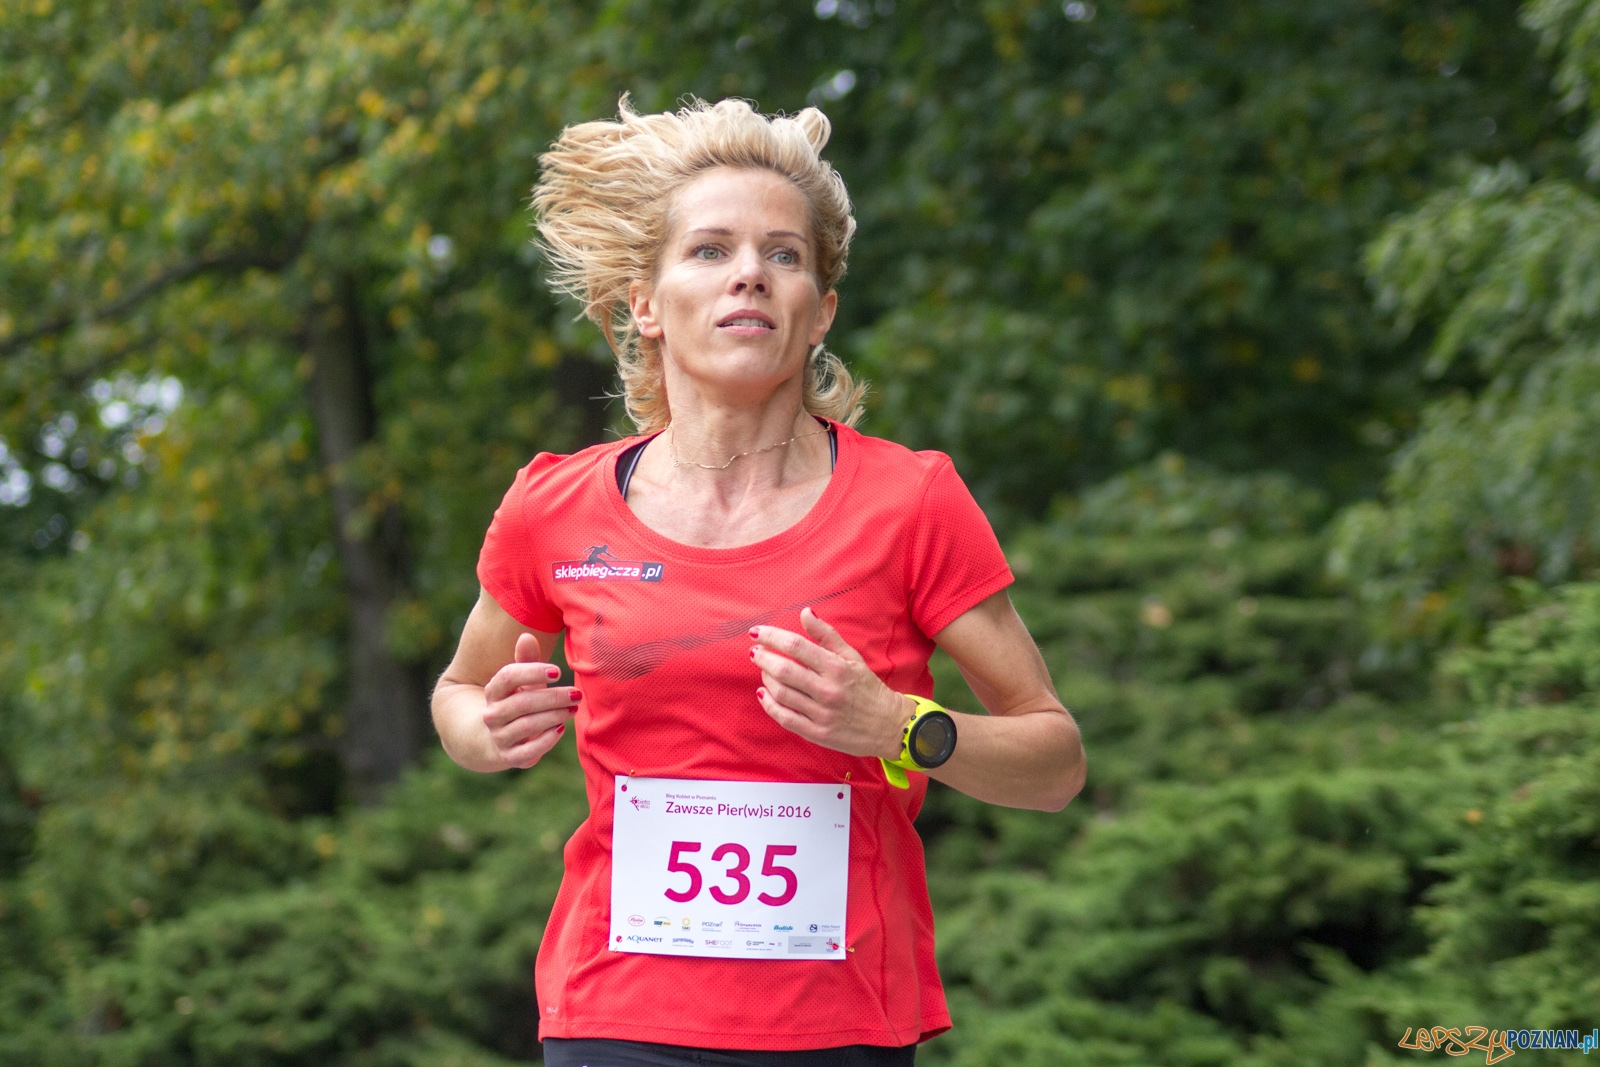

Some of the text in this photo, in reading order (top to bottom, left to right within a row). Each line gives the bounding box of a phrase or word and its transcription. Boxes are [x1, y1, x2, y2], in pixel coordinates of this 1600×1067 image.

[665, 801, 812, 819] Zawsze Pier(w)si 2016
[664, 840, 798, 907] 535
